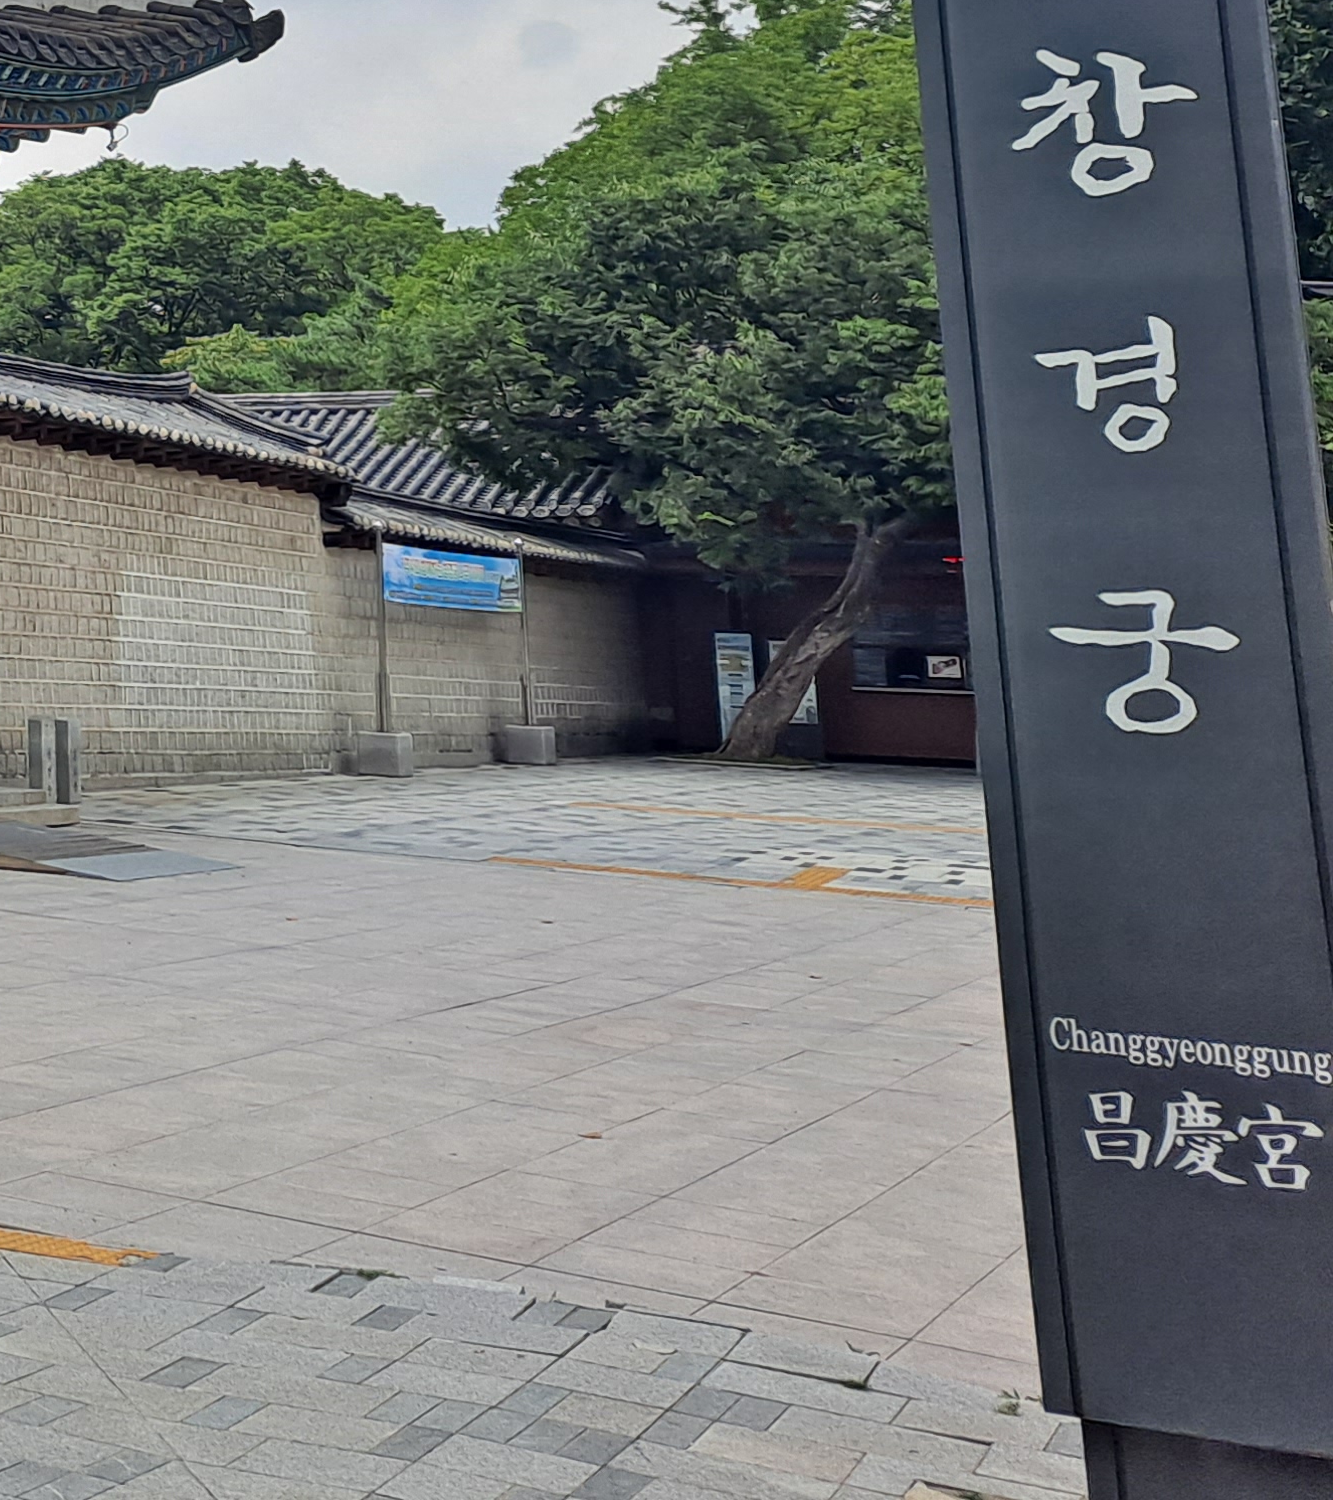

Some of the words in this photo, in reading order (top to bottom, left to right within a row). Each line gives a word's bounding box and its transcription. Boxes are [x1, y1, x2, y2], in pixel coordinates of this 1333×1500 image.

[1049, 1016, 1333, 1085] Changgyeonggung
[1083, 1090, 1325, 1191] 昌慶宮
